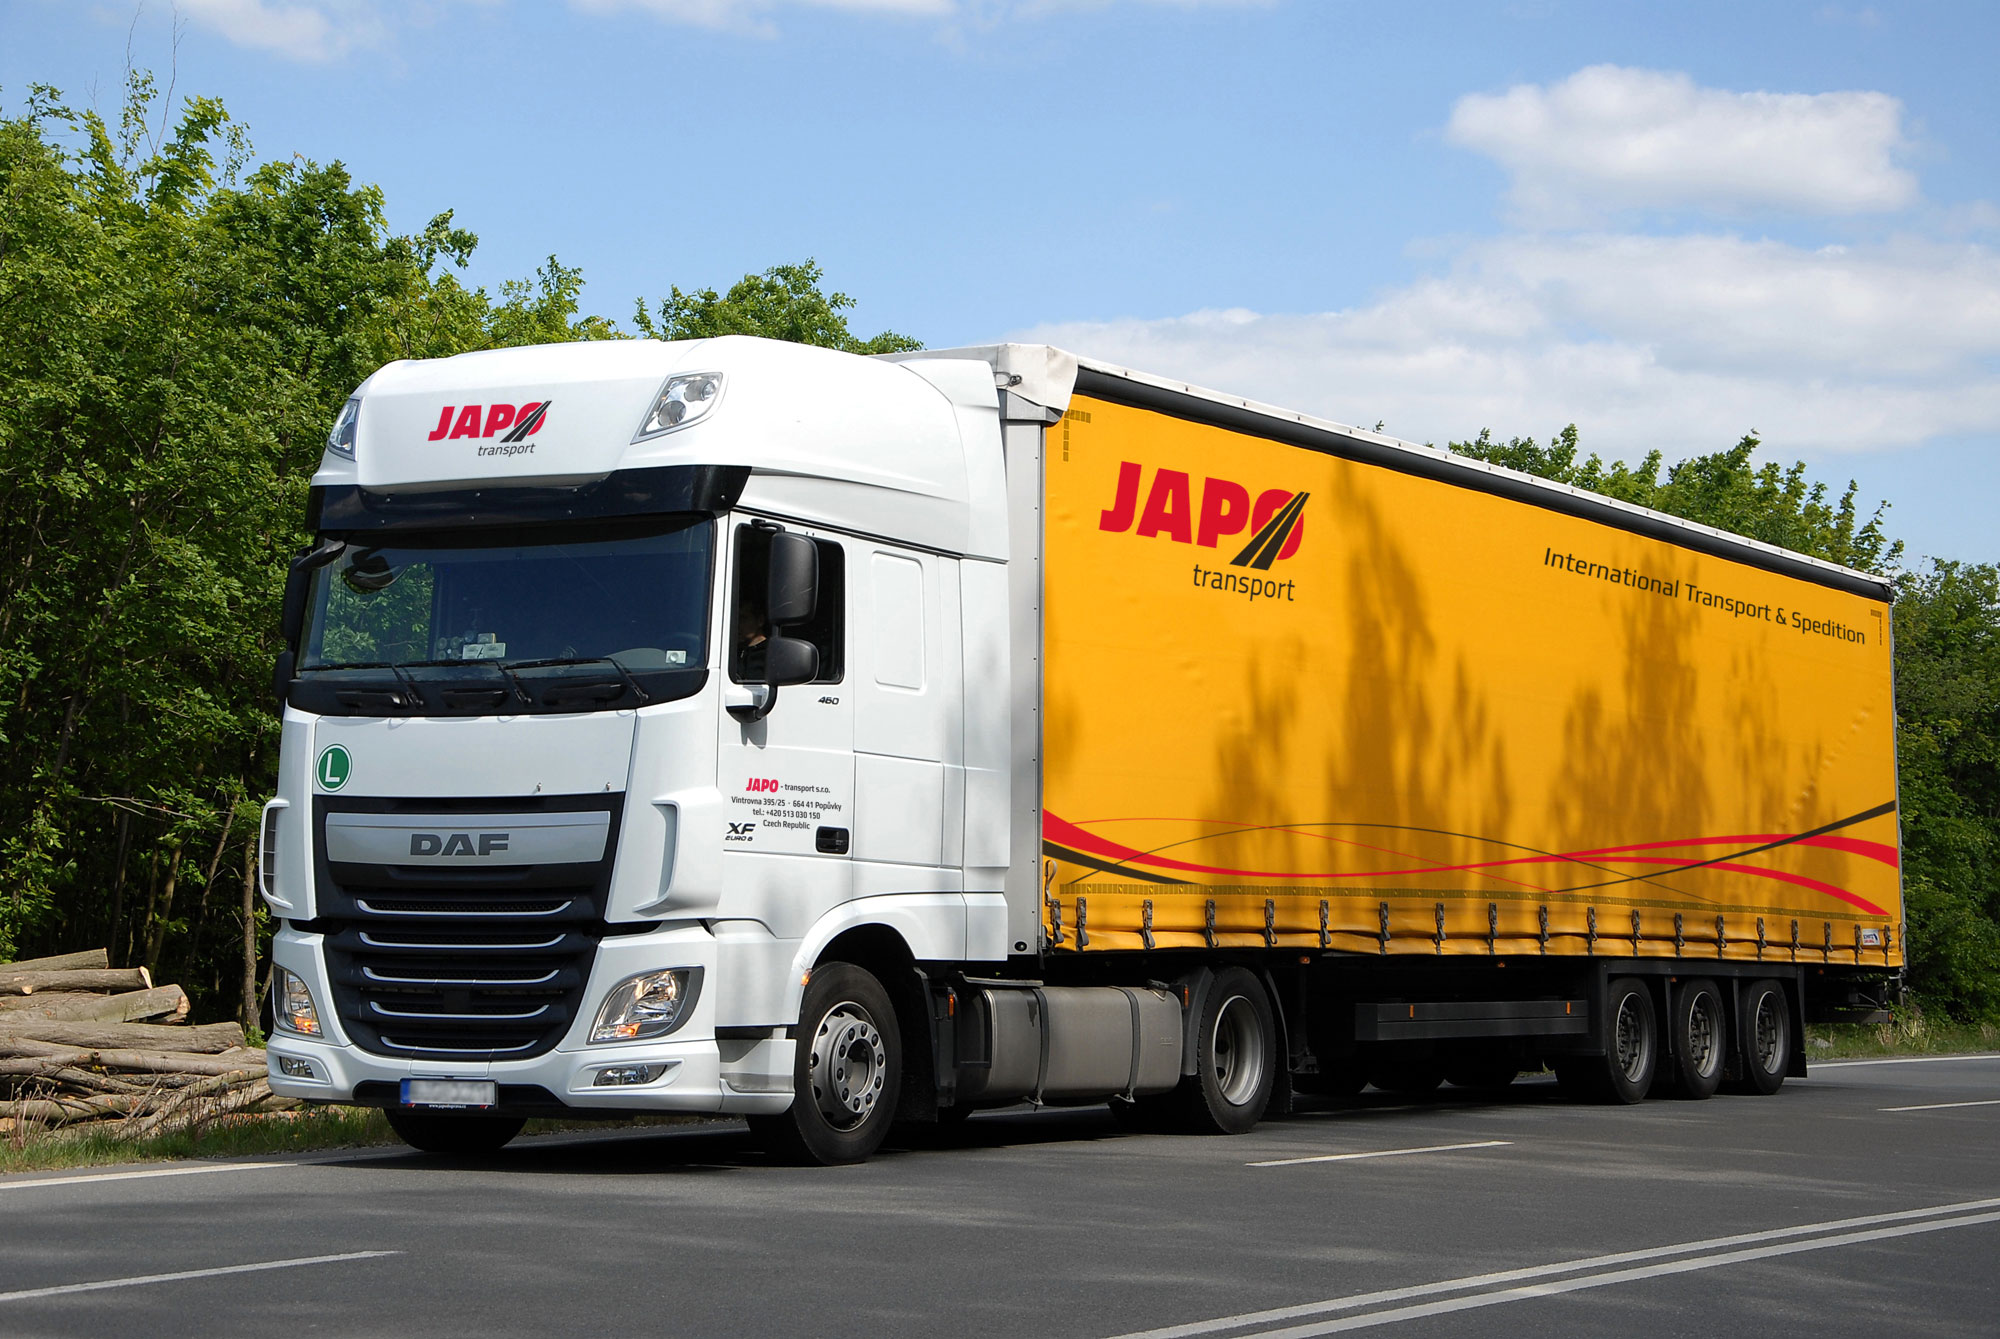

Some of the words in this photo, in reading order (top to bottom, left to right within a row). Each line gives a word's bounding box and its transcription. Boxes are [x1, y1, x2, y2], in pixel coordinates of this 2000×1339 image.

[428, 401, 549, 441] JAPO
[477, 443, 536, 457] transport
[1099, 461, 1305, 564] JAPO
[1193, 564, 1296, 602] transport
[1544, 547, 1679, 598] International
[1685, 583, 1771, 621] Transport
[1776, 607, 1787, 625] &
[1792, 611, 1866, 645] Spedition
[817, 696, 840, 705] 460
[325, 753, 340, 783] L
[745, 777, 779, 793] JAPO
[784, 783, 815, 794] transport
[815, 786, 831, 794] s.r.o.
[731, 796, 762, 806] Vintrovna
[763, 798, 786, 807] 395/25
[792, 799, 805, 808] 664
[805, 801, 814, 809] 41
[814, 801, 842, 812] Popůvky
[752, 808, 765, 816] tel.:
[766, 809, 781, 817] +420
[782, 810, 794, 818] 513
[795, 811, 808, 819] 030
[809, 812, 821, 820] 150
[726, 822, 756, 835] XF
[762, 819, 782, 828] Czech
[782, 820, 810, 830] Republic
[410, 833, 510, 856] DAF
